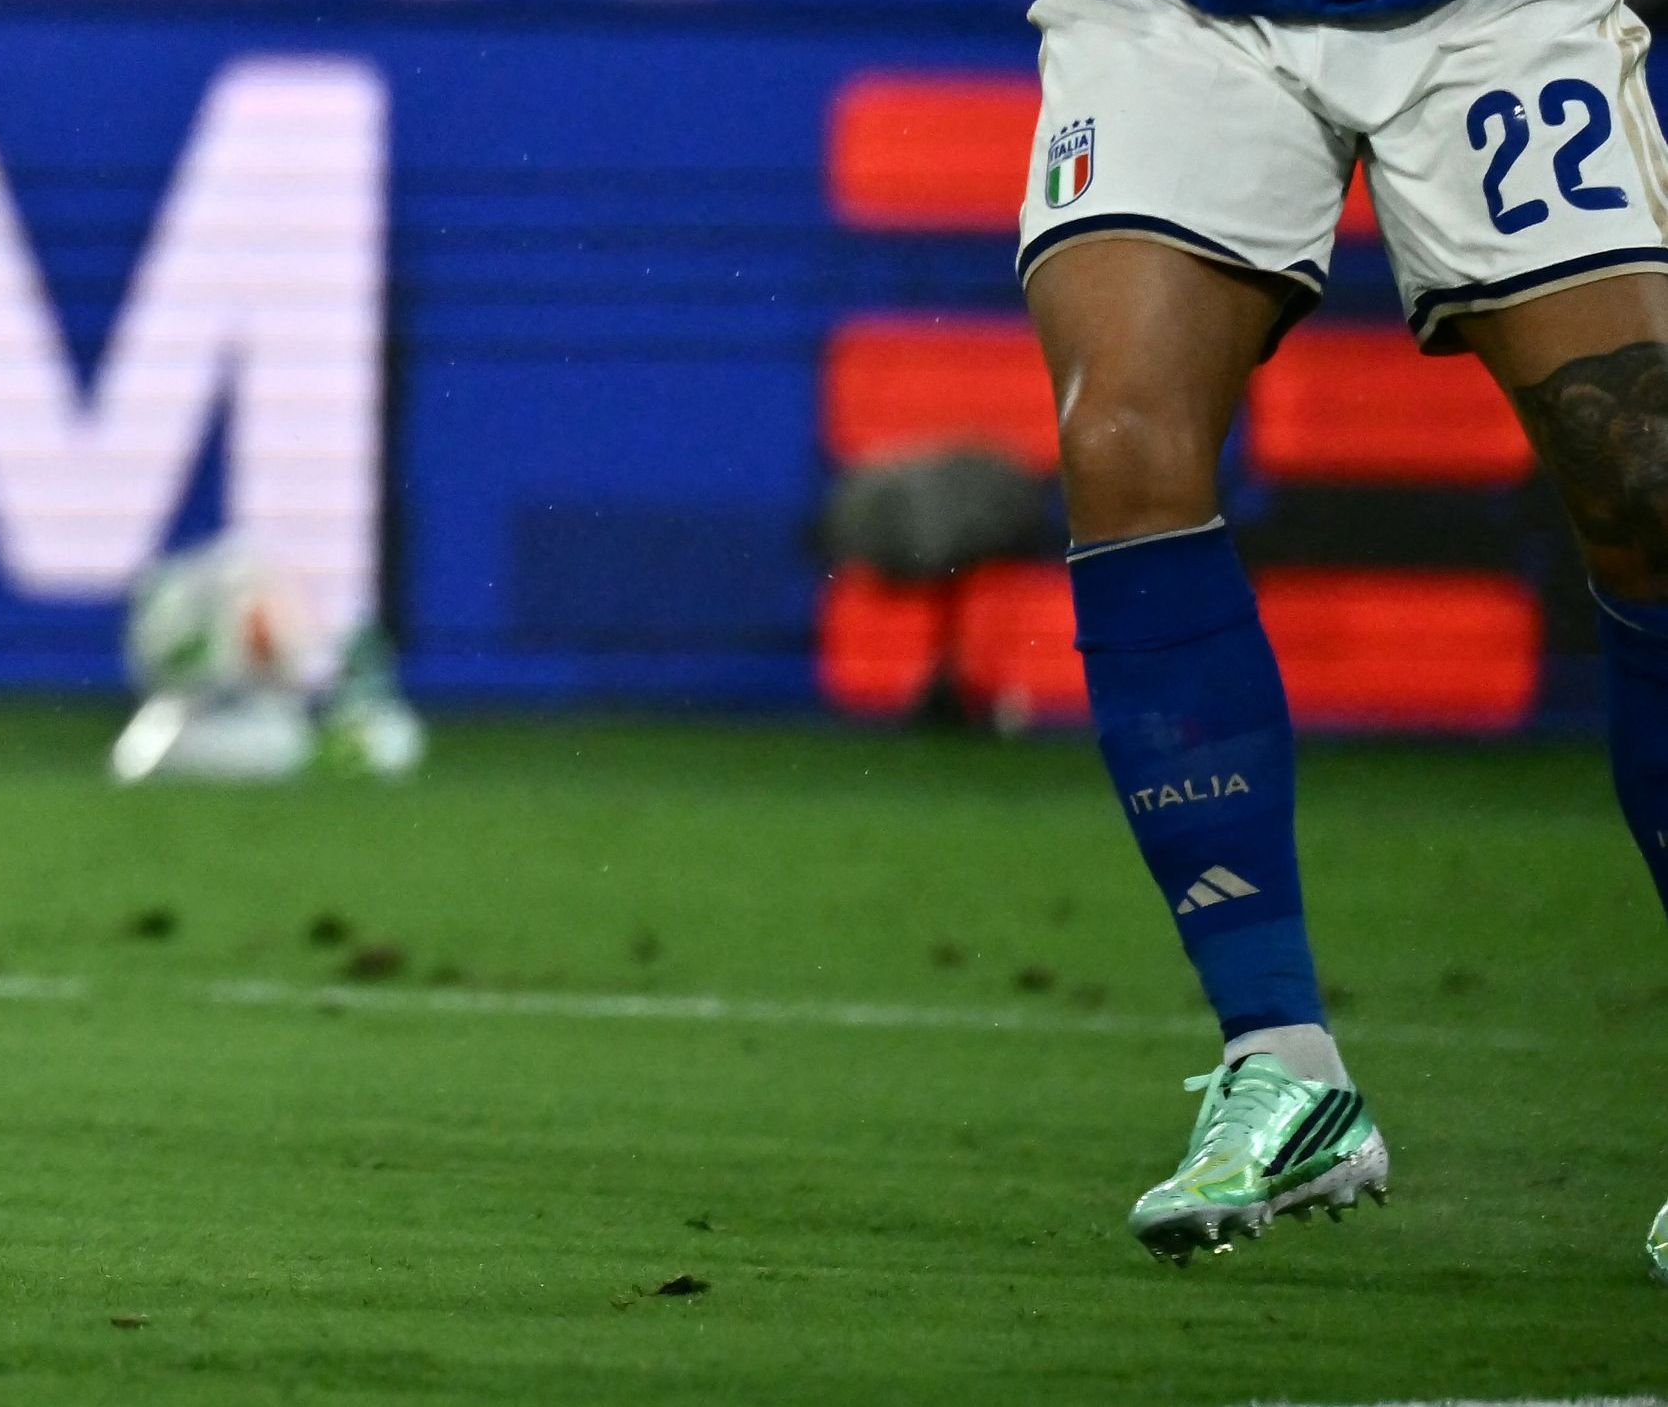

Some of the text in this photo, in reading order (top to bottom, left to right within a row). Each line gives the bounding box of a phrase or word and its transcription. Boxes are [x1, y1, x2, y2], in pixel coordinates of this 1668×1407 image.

[1050, 134, 1089, 162] ITALIA
[1466, 78, 1629, 235] 22
[1129, 773, 1249, 815] ITALIA
